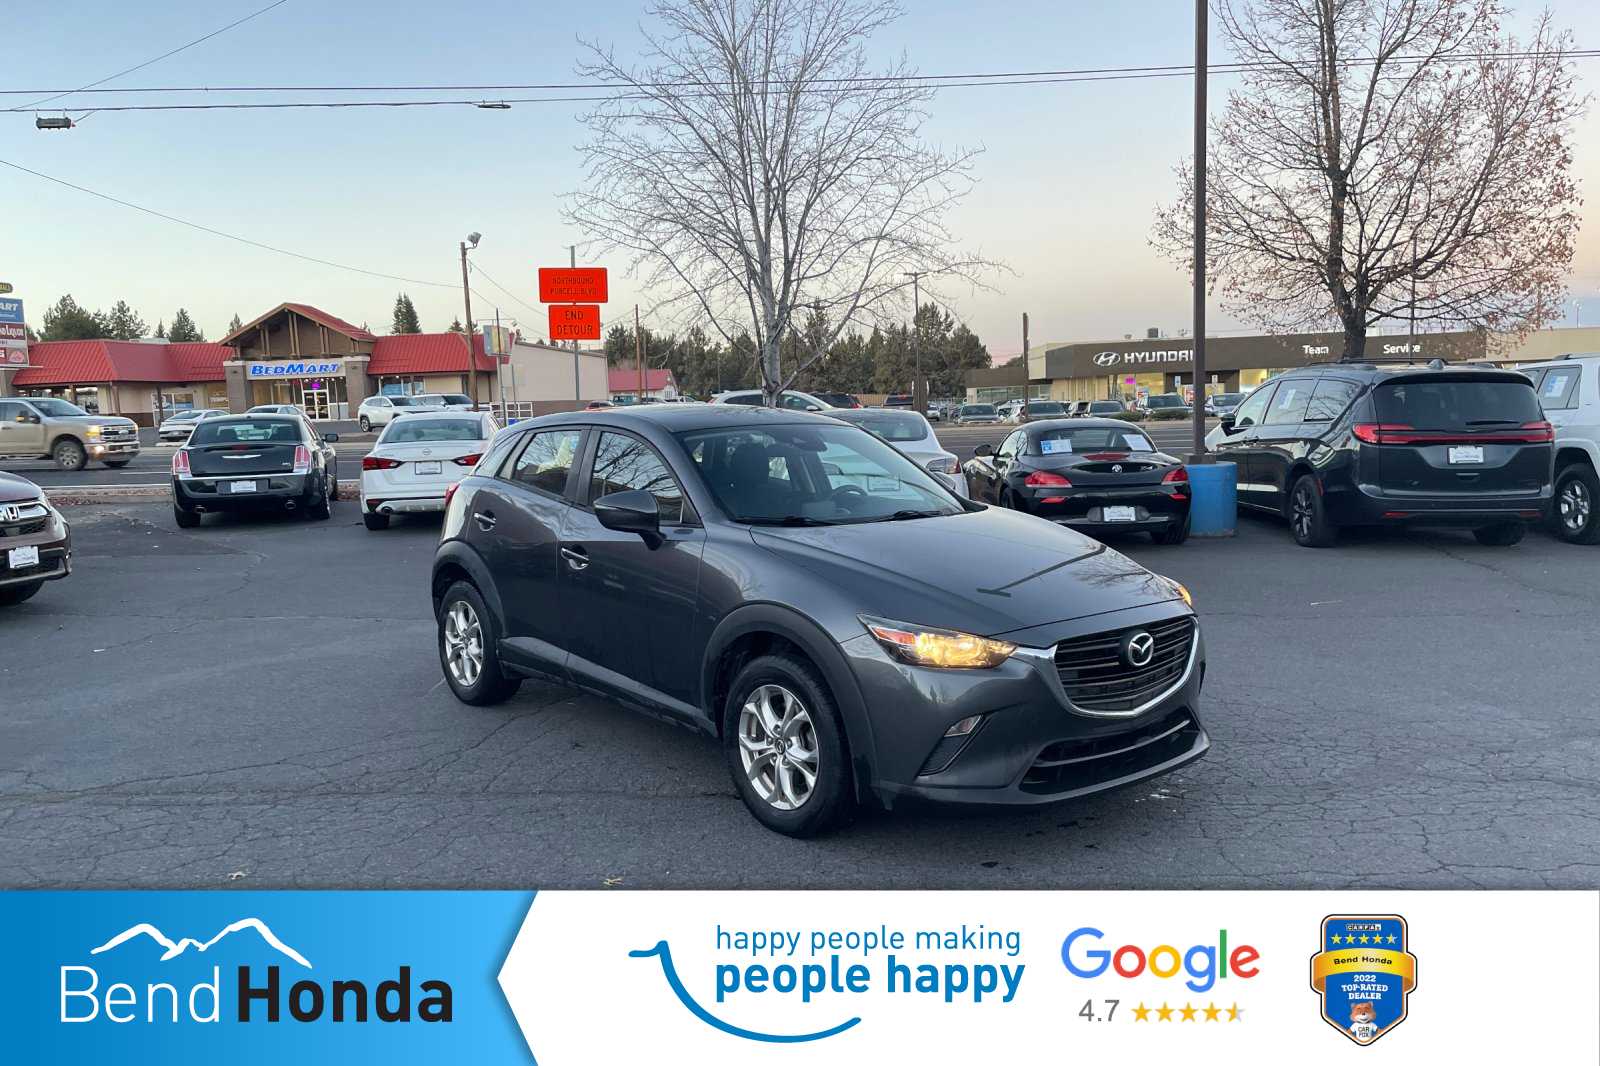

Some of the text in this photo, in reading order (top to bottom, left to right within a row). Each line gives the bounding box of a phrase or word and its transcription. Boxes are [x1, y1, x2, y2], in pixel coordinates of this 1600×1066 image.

[564, 310, 584, 321] END
[556, 324, 593, 335] DETOUR
[1302, 344, 1330, 355] Team
[1383, 342, 1421, 354] Servie
[1124, 349, 1194, 363] HYUNDAI
